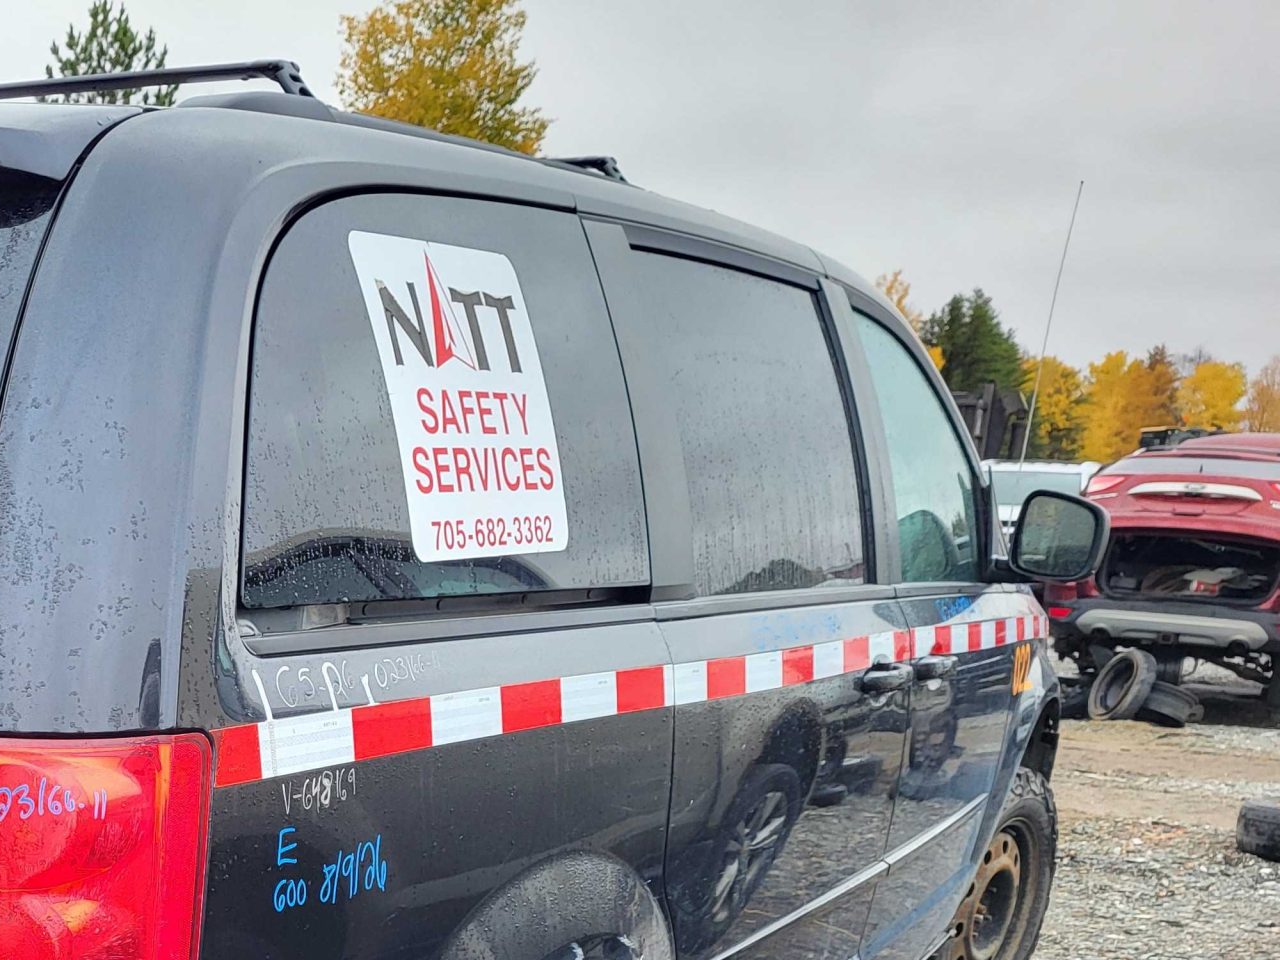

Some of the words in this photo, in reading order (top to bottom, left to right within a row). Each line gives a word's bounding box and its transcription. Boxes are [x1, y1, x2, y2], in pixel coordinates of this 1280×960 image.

[375, 249, 523, 374] NATT
[416, 387, 529, 435] SAFETY
[412, 446, 555, 495] SERVICES
[431, 515, 554, 551] 705-682-3362
[1012, 643, 1034, 696] 022
[277, 827, 298, 866] E
[274, 879, 307, 912] 600
